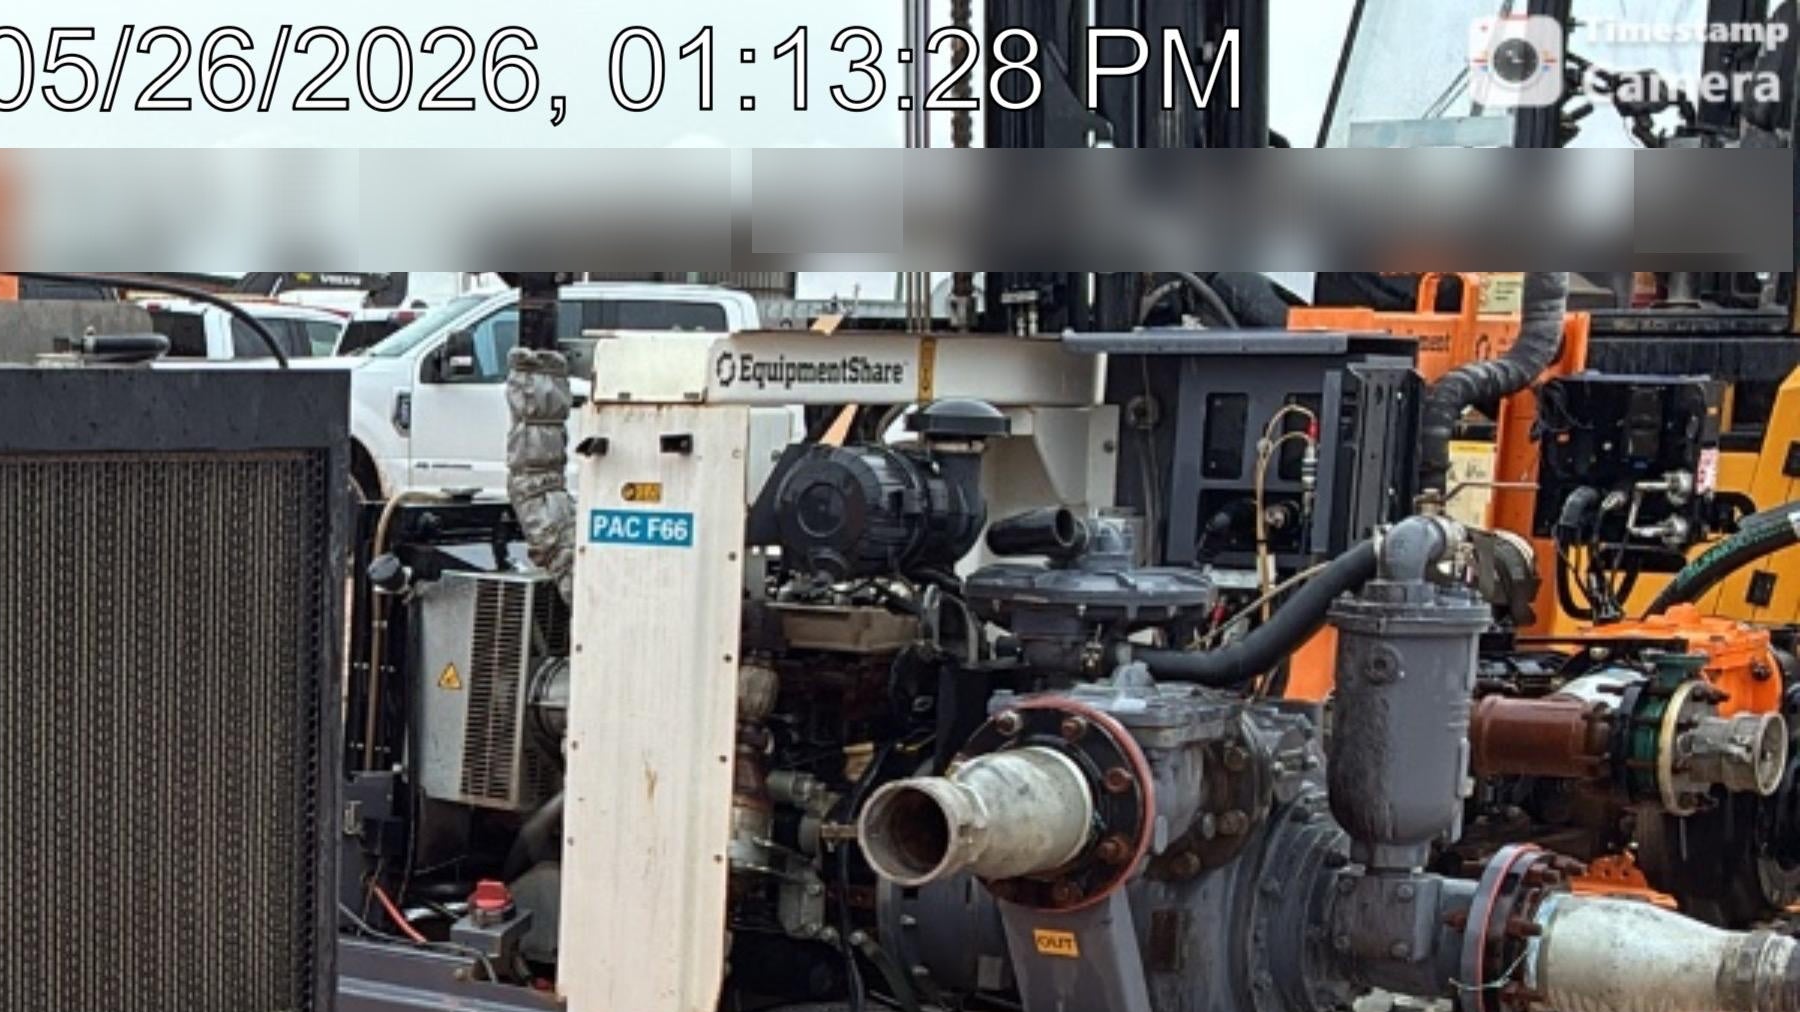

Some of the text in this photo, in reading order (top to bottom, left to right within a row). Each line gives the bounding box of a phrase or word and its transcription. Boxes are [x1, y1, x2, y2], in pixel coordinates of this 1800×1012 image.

[739, 354, 904, 389] EquipmentShare
[593, 515, 688, 541] PAC F66
